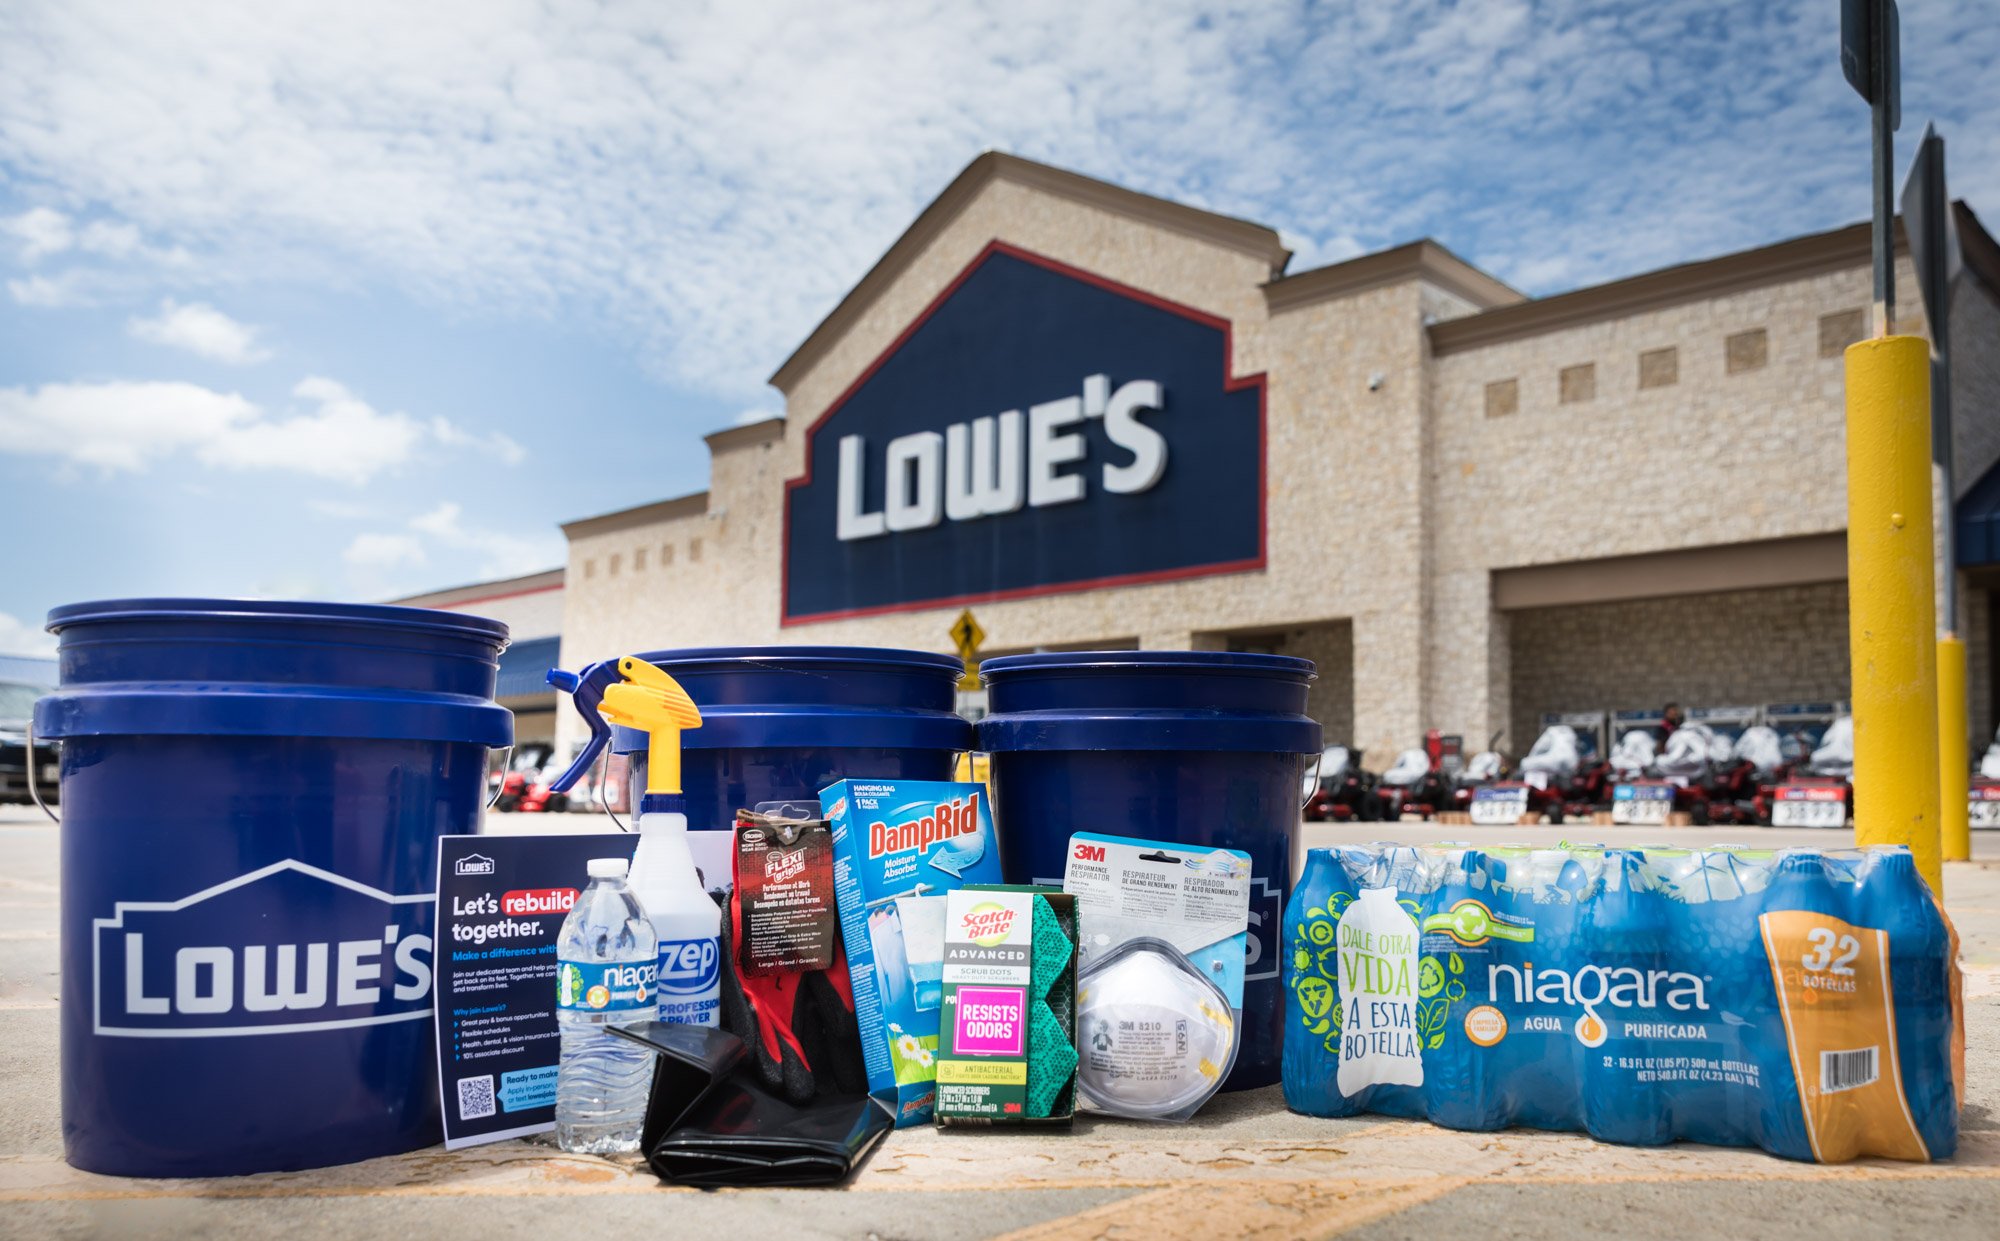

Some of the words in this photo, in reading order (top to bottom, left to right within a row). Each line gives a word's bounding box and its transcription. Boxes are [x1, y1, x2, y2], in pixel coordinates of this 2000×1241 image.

[836, 373, 1168, 541] LOWE'S
[856, 799, 861, 809] 1
[869, 792, 979, 859] DampRid
[1074, 844, 1105, 862] 3M
[460, 861, 490, 872] LOWE'S
[767, 851, 801, 875] FLEXI
[884, 855, 916, 869] Moisture
[1072, 864, 1108, 873] PERFORMANCE
[776, 868, 794, 880] grip
[884, 863, 917, 879] Absorber
[1070, 870, 1110, 881] RESPIRATOR
[1122, 870, 1166, 882] RESPIRATEUR
[762, 883, 791, 892] Performance
[1148, 881, 1178, 890] RENDEMENT
[1184, 877, 1224, 888] RESPIRADOR
[1205, 887, 1239, 896] RENDIMIENTO
[454, 892, 498, 915] Let's
[506, 891, 574, 912] rebuild
[452, 918, 544, 944] together.
[968, 922, 1009, 938] Brite
[1343, 924, 1372, 951] DALE
[1379, 934, 1411, 955] OTRA
[453, 950, 479, 960] Make
[490, 946, 536, 958] difference
[950, 950, 1025, 960] ADVANCED
[1802, 927, 1860, 976] 32
[659, 941, 714, 980] zep
[125, 924, 433, 1015] LOWE'S
[533, 964, 545, 972] help
[1343, 952, 1411, 996] VIDA
[510, 973, 535, 981] Together,
[1803, 975, 1856, 992] BOTELLAS
[1488, 962, 1710, 1026] niagara
[470, 1006, 481, 1015] join
[482, 1004, 507, 1013] Lowe's?
[514, 1011, 549, 1022] opportunities
[962, 1004, 1018, 1020] RESISTS
[1348, 998, 1360, 1030] A
[1371, 1002, 1410, 1029] ESTA
[462, 1030, 482, 1038] Flexible
[484, 1027, 510, 1035] schedules
[966, 1022, 1012, 1039] ODORS
[1119, 1021, 1134, 1030] 3M
[1139, 1022, 1161, 1031] 8210
[1524, 1017, 1562, 1031] AGUA
[1624, 1023, 1707, 1040] PURIFICADA
[525, 1033, 550, 1041] insurance
[1178, 1024, 1186, 1051] N95
[475, 1049, 500, 1058] associate
[502, 1046, 524, 1054] discount
[1345, 1032, 1415, 1061] BOTELLA
[965, 1066, 1013, 1074] ANTIBACTERIAL
[1603, 1056, 1612, 1067] 32
[1619, 1058, 1633, 1068] 16.9
[1636, 1058, 1644, 1068] FL
[1645, 1058, 1654, 1068] OZ
[1676, 1058, 1689, 1069] PT)
[1691, 1058, 1706, 1068] 500
[1709, 1060, 1720, 1070] mL
[1722, 1060, 1759, 1076] BOTELLAS
[506, 1076, 528, 1084] Ready
[539, 1070, 558, 1079] make
[1637, 1071, 1656, 1082] NETO
[1657, 1071, 1677, 1081] 540.8
[1679, 1070, 1687, 1080] FL
[1689, 1070, 1699, 1080] OZ
[1701, 1070, 1723, 1081] (4.23
[1725, 1074, 1745, 1084] GAL)
[1746, 1075, 1754, 1086] 16
[507, 1086, 524, 1094] Apply
[526, 1083, 554, 1091] in-person,
[1004, 1103, 1021, 1113] 3M
